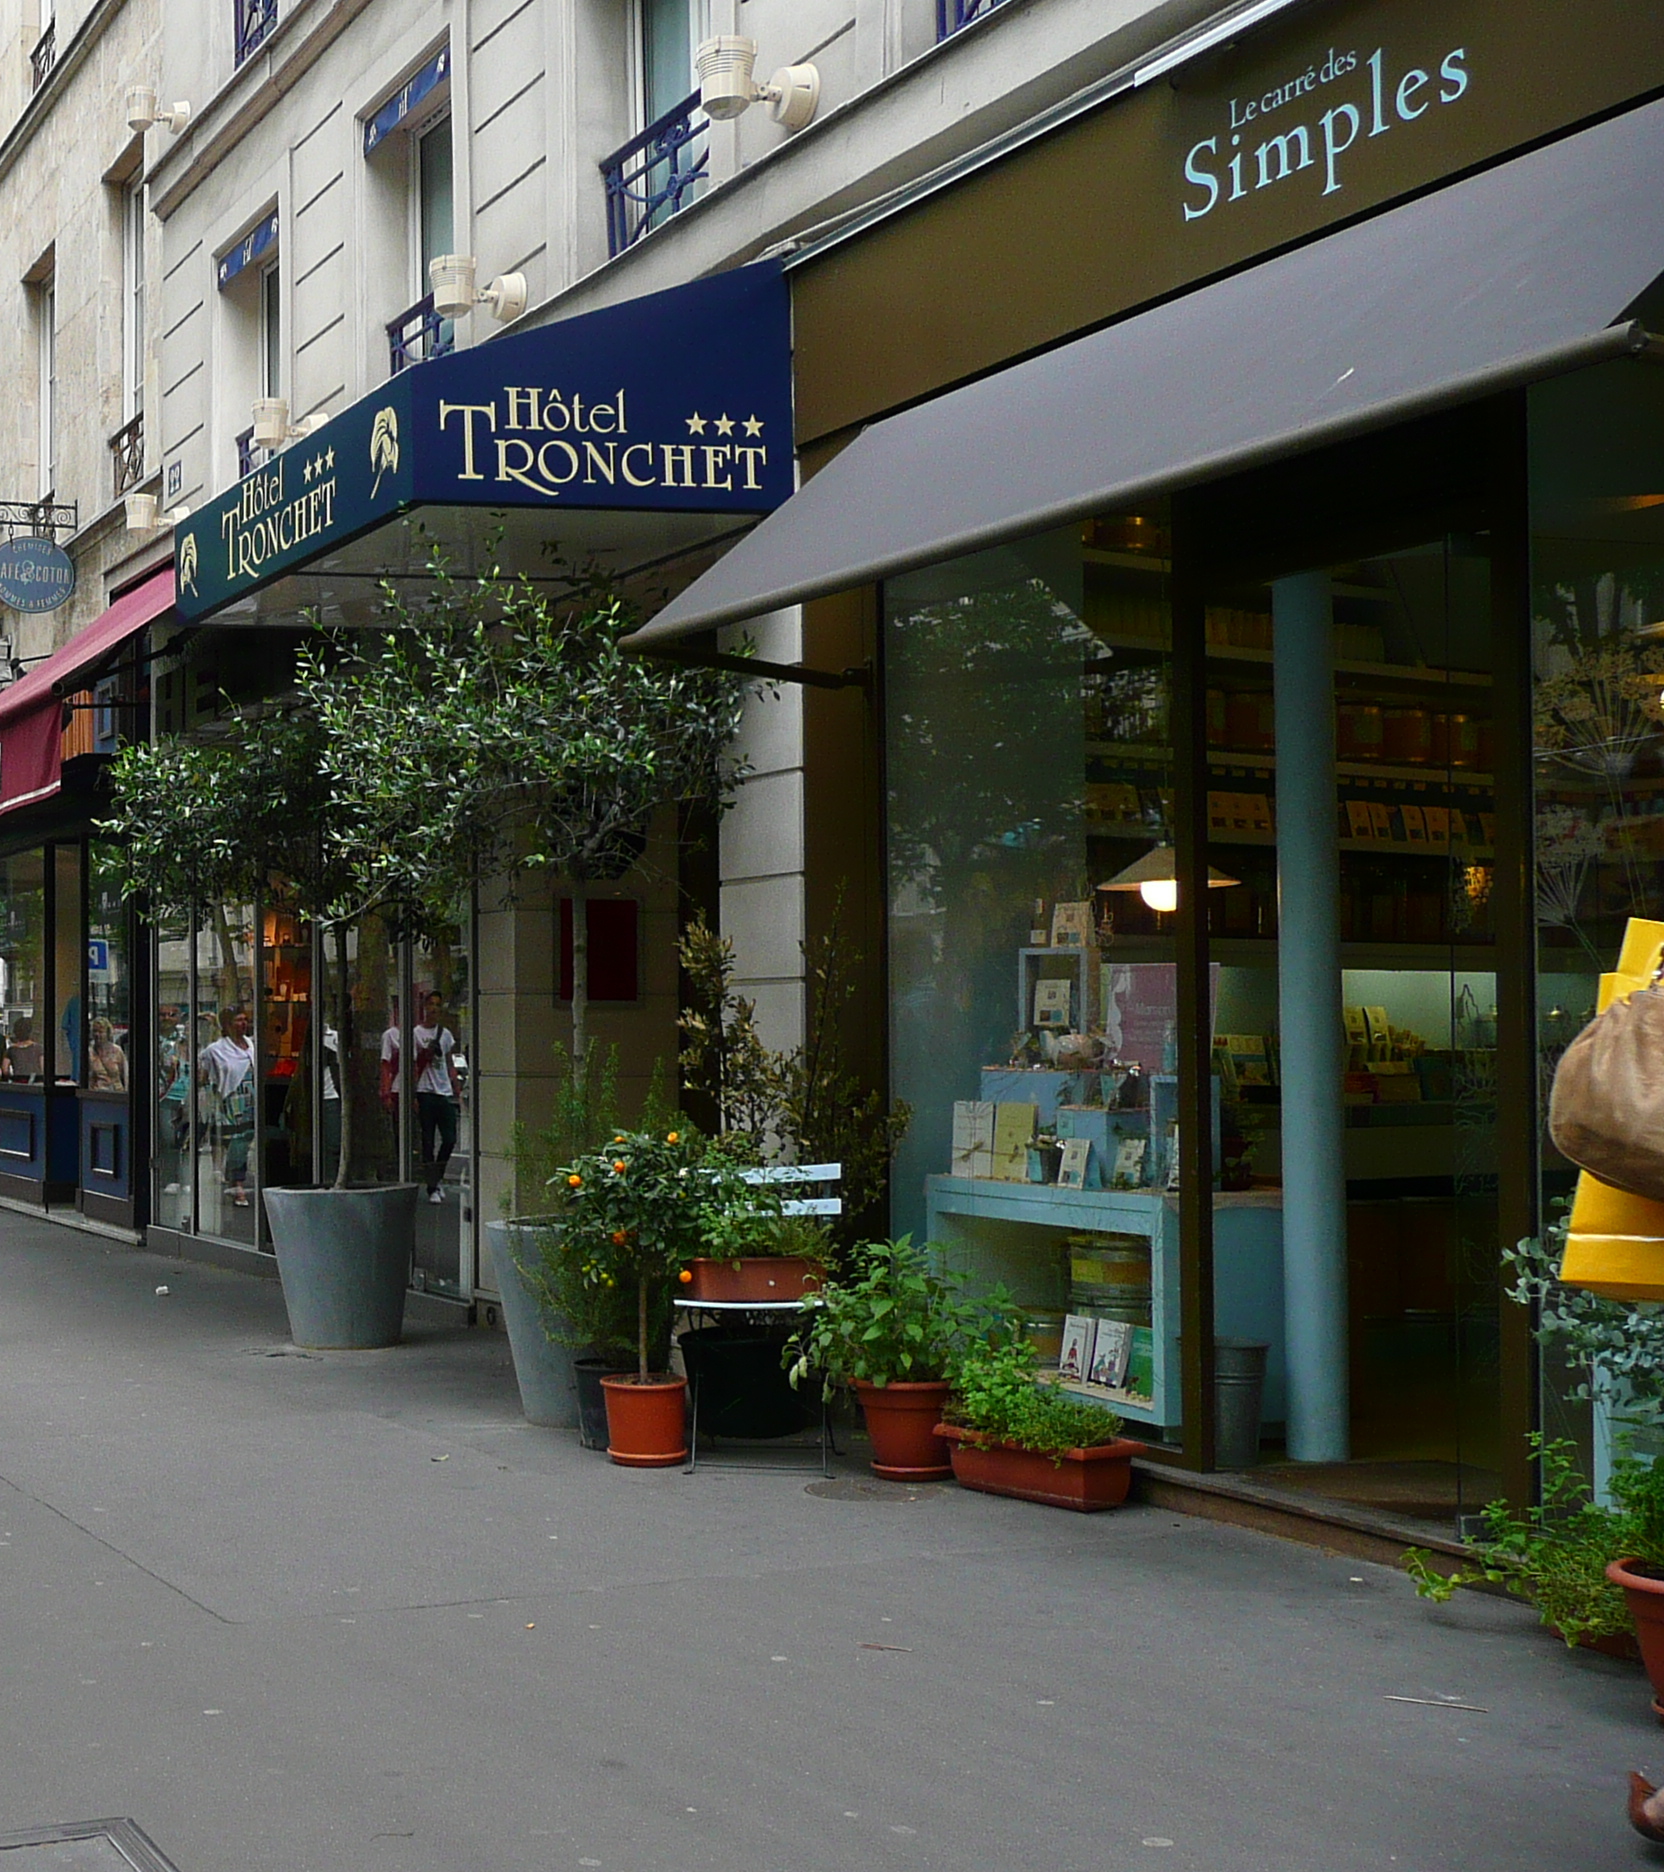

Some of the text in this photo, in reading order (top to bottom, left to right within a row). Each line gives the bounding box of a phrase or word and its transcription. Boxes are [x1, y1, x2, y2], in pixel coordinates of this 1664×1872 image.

[1229, 47, 1357, 129] Le carré des
[1183, 47, 1468, 222] Simples
[439, 399, 767, 496] TRONCHET
[504, 386, 628, 435] Hôtel
[222, 476, 336, 581] TRONCHET
[241, 455, 284, 524] Hôtel
[35, 565, 70, 585] COTON
